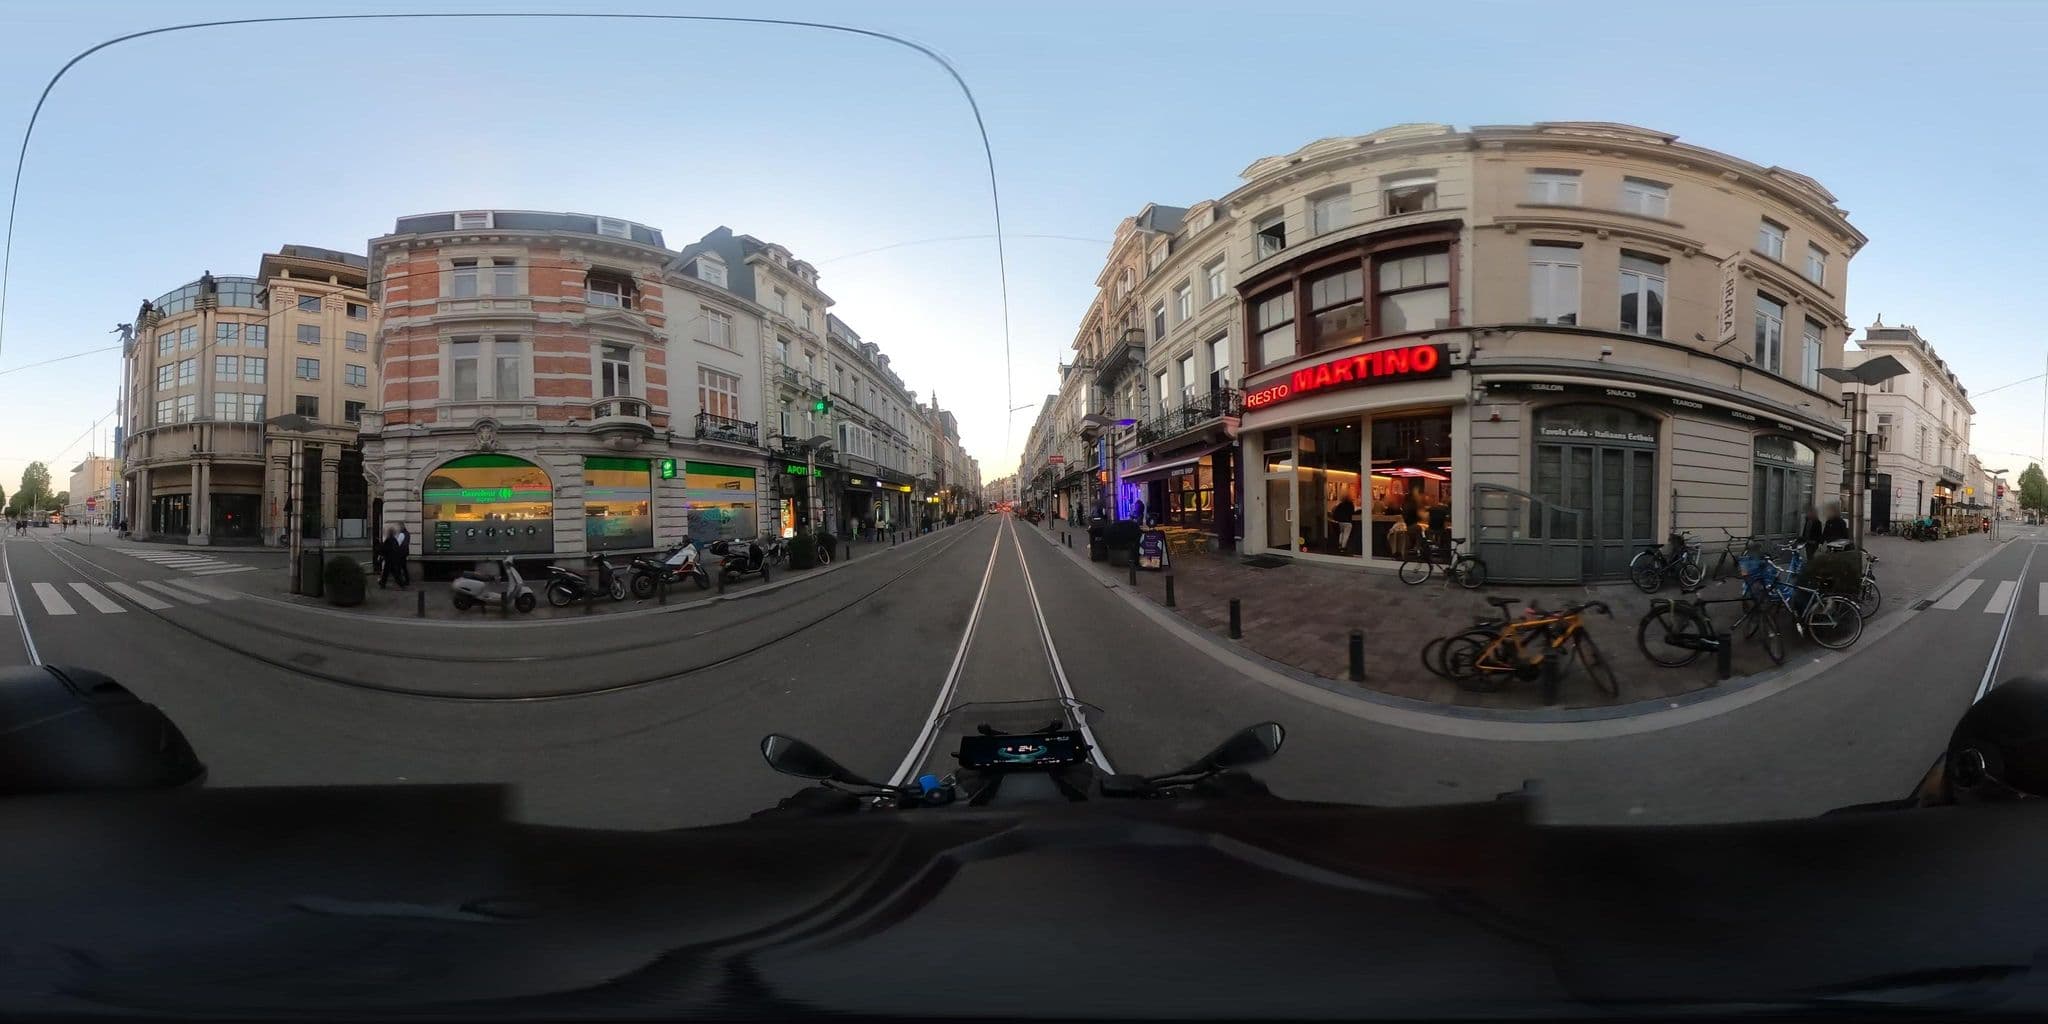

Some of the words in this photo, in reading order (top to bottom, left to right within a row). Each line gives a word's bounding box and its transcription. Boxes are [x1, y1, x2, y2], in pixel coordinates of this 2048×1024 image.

[1247, 384, 1294, 407] RESTO
[1292, 344, 1440, 394] MARTINO
[1605, 389, 1637, 398] SNACKS
